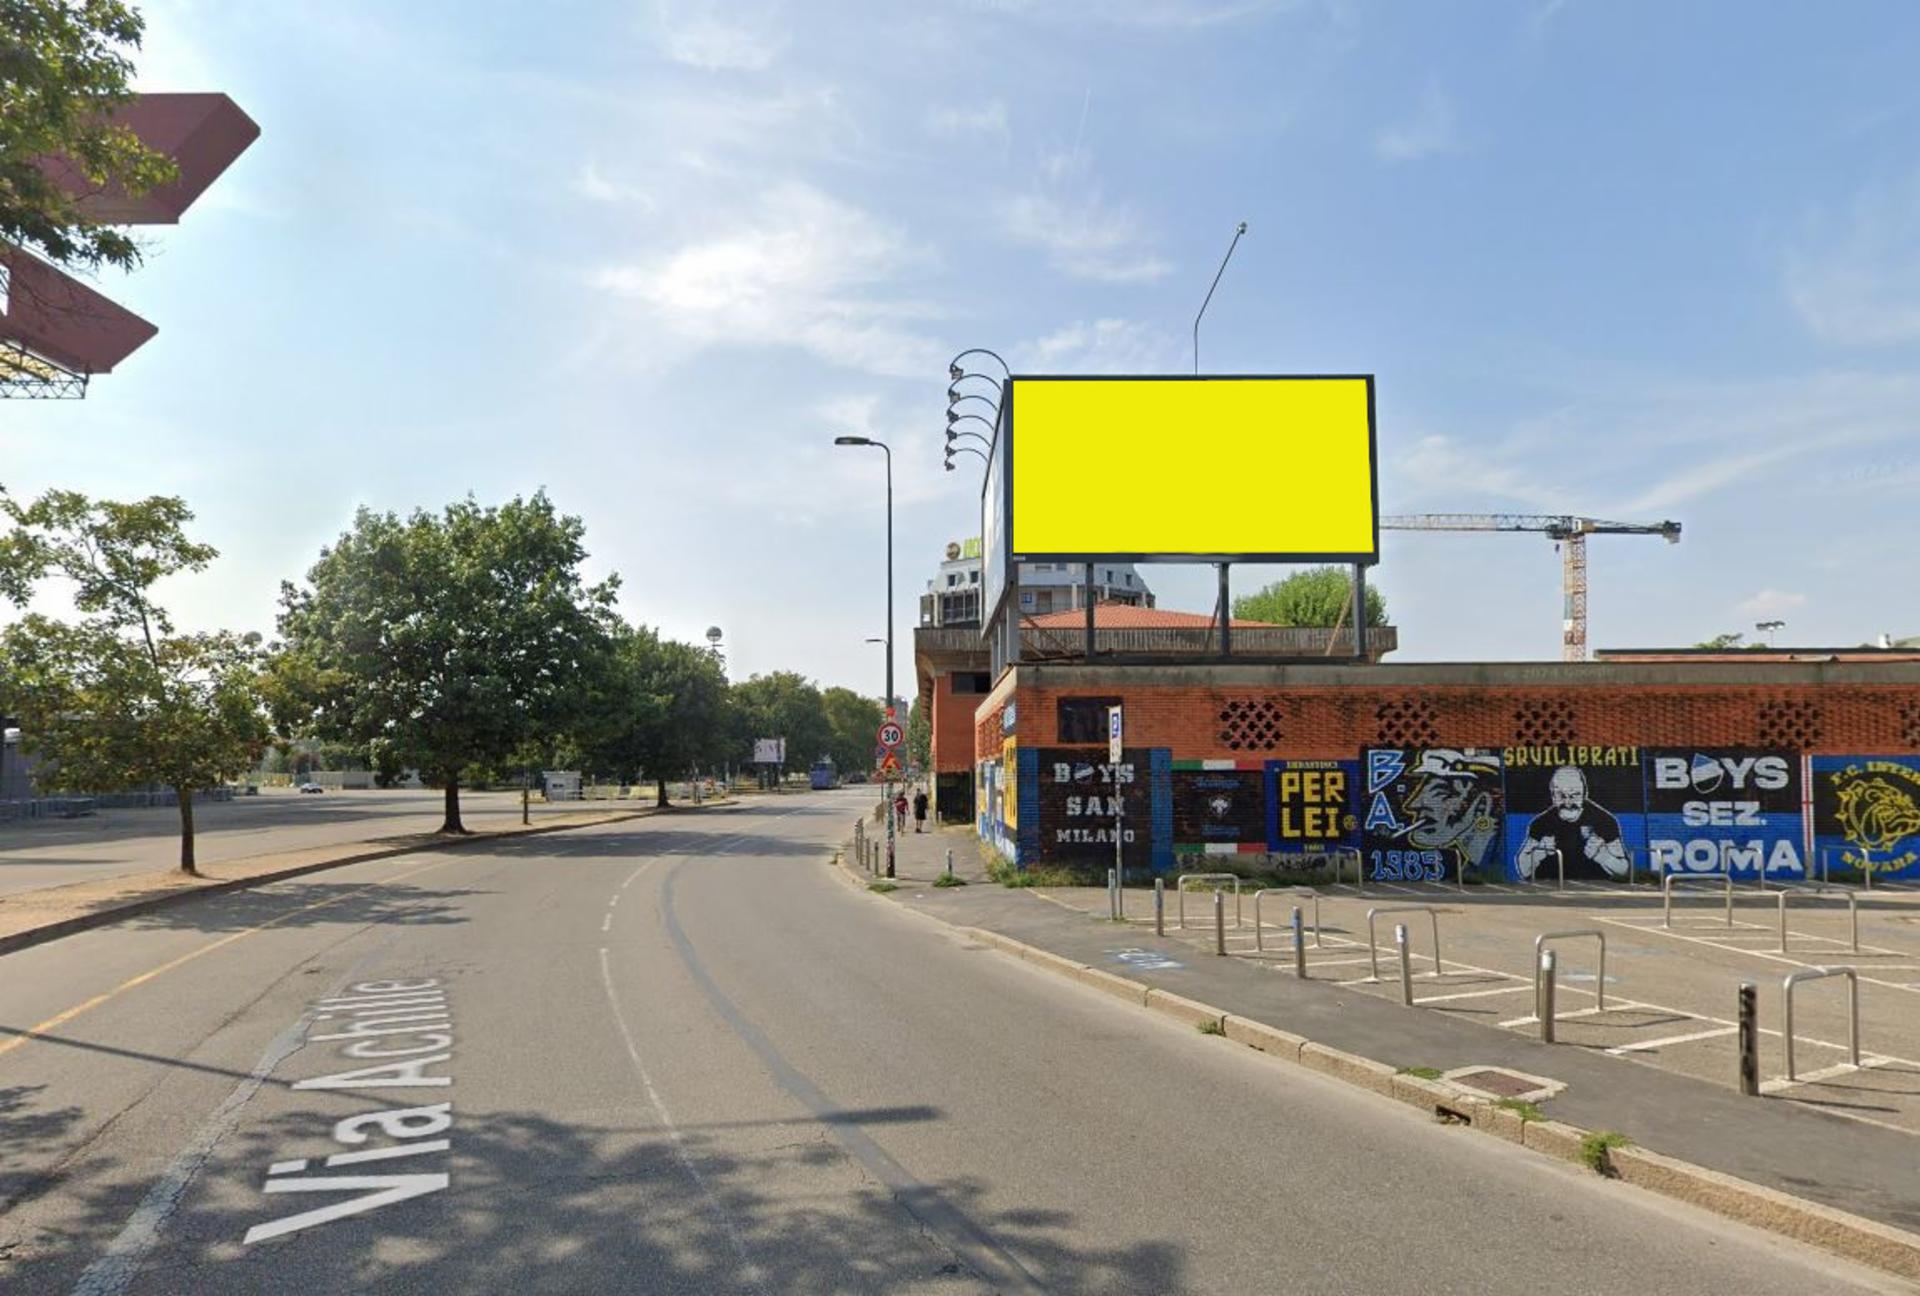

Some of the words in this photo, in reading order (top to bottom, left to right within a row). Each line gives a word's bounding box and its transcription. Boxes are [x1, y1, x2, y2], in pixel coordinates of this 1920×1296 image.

[884, 729, 899, 742] 30
[1281, 771, 1345, 803] PER
[1066, 796, 1126, 817] SAN
[1682, 801, 1767, 826] SEZ.
[1281, 807, 1341, 839] LEI
[1650, 839, 1804, 872] ROMA
